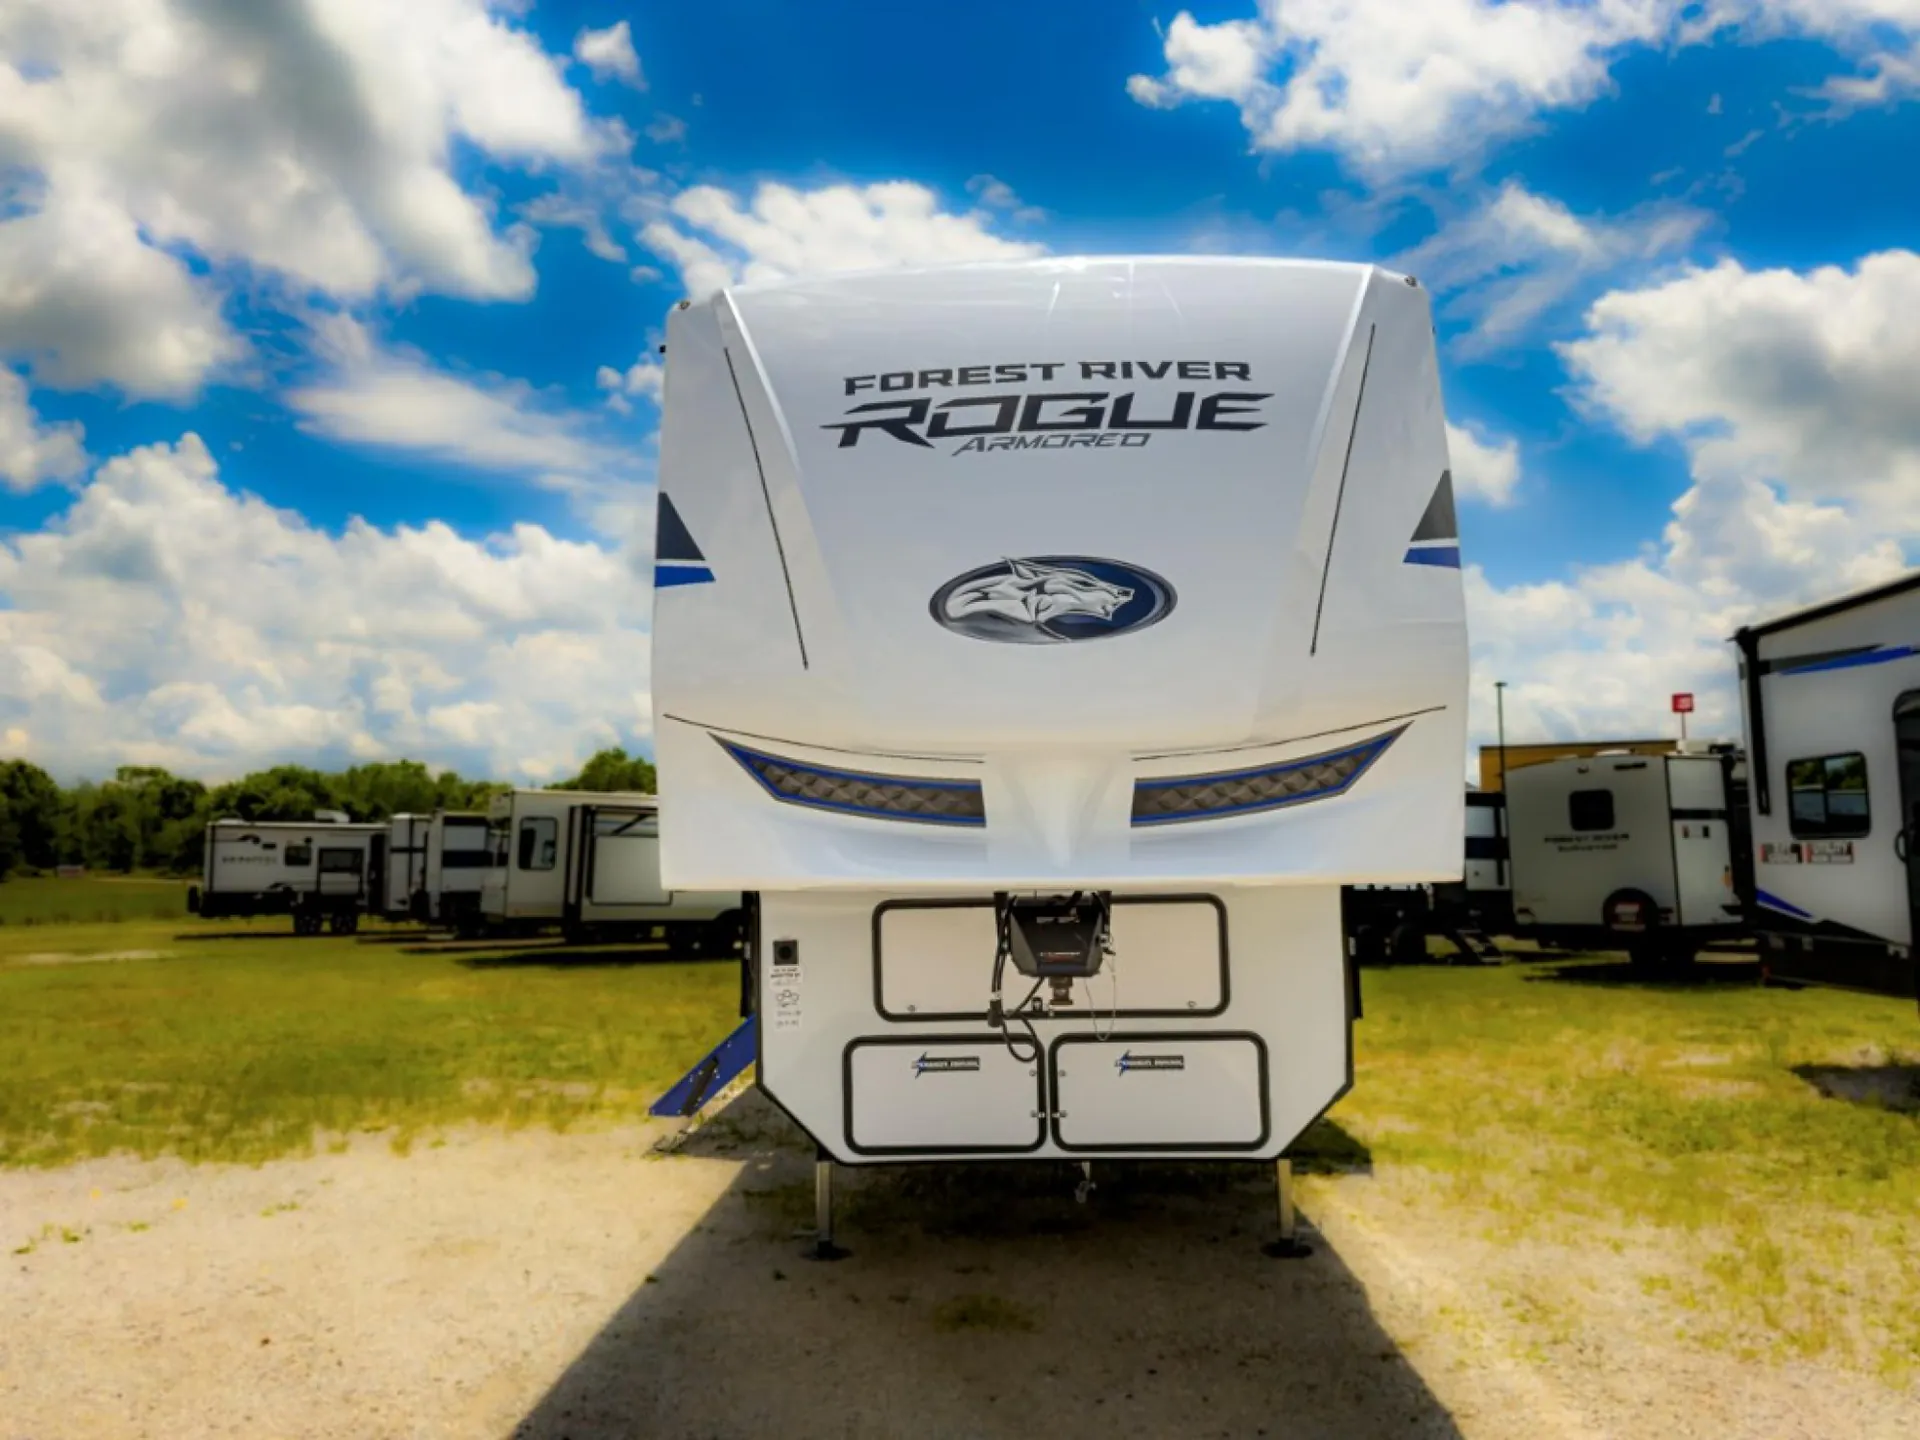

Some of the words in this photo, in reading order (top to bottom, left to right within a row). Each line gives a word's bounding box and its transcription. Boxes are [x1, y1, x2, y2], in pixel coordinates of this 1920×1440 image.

[844, 363, 1065, 396] FOREST
[1078, 361, 1252, 381] RIVER
[819, 391, 1276, 449] ROGUE
[951, 432, 1152, 457] ARMORED
